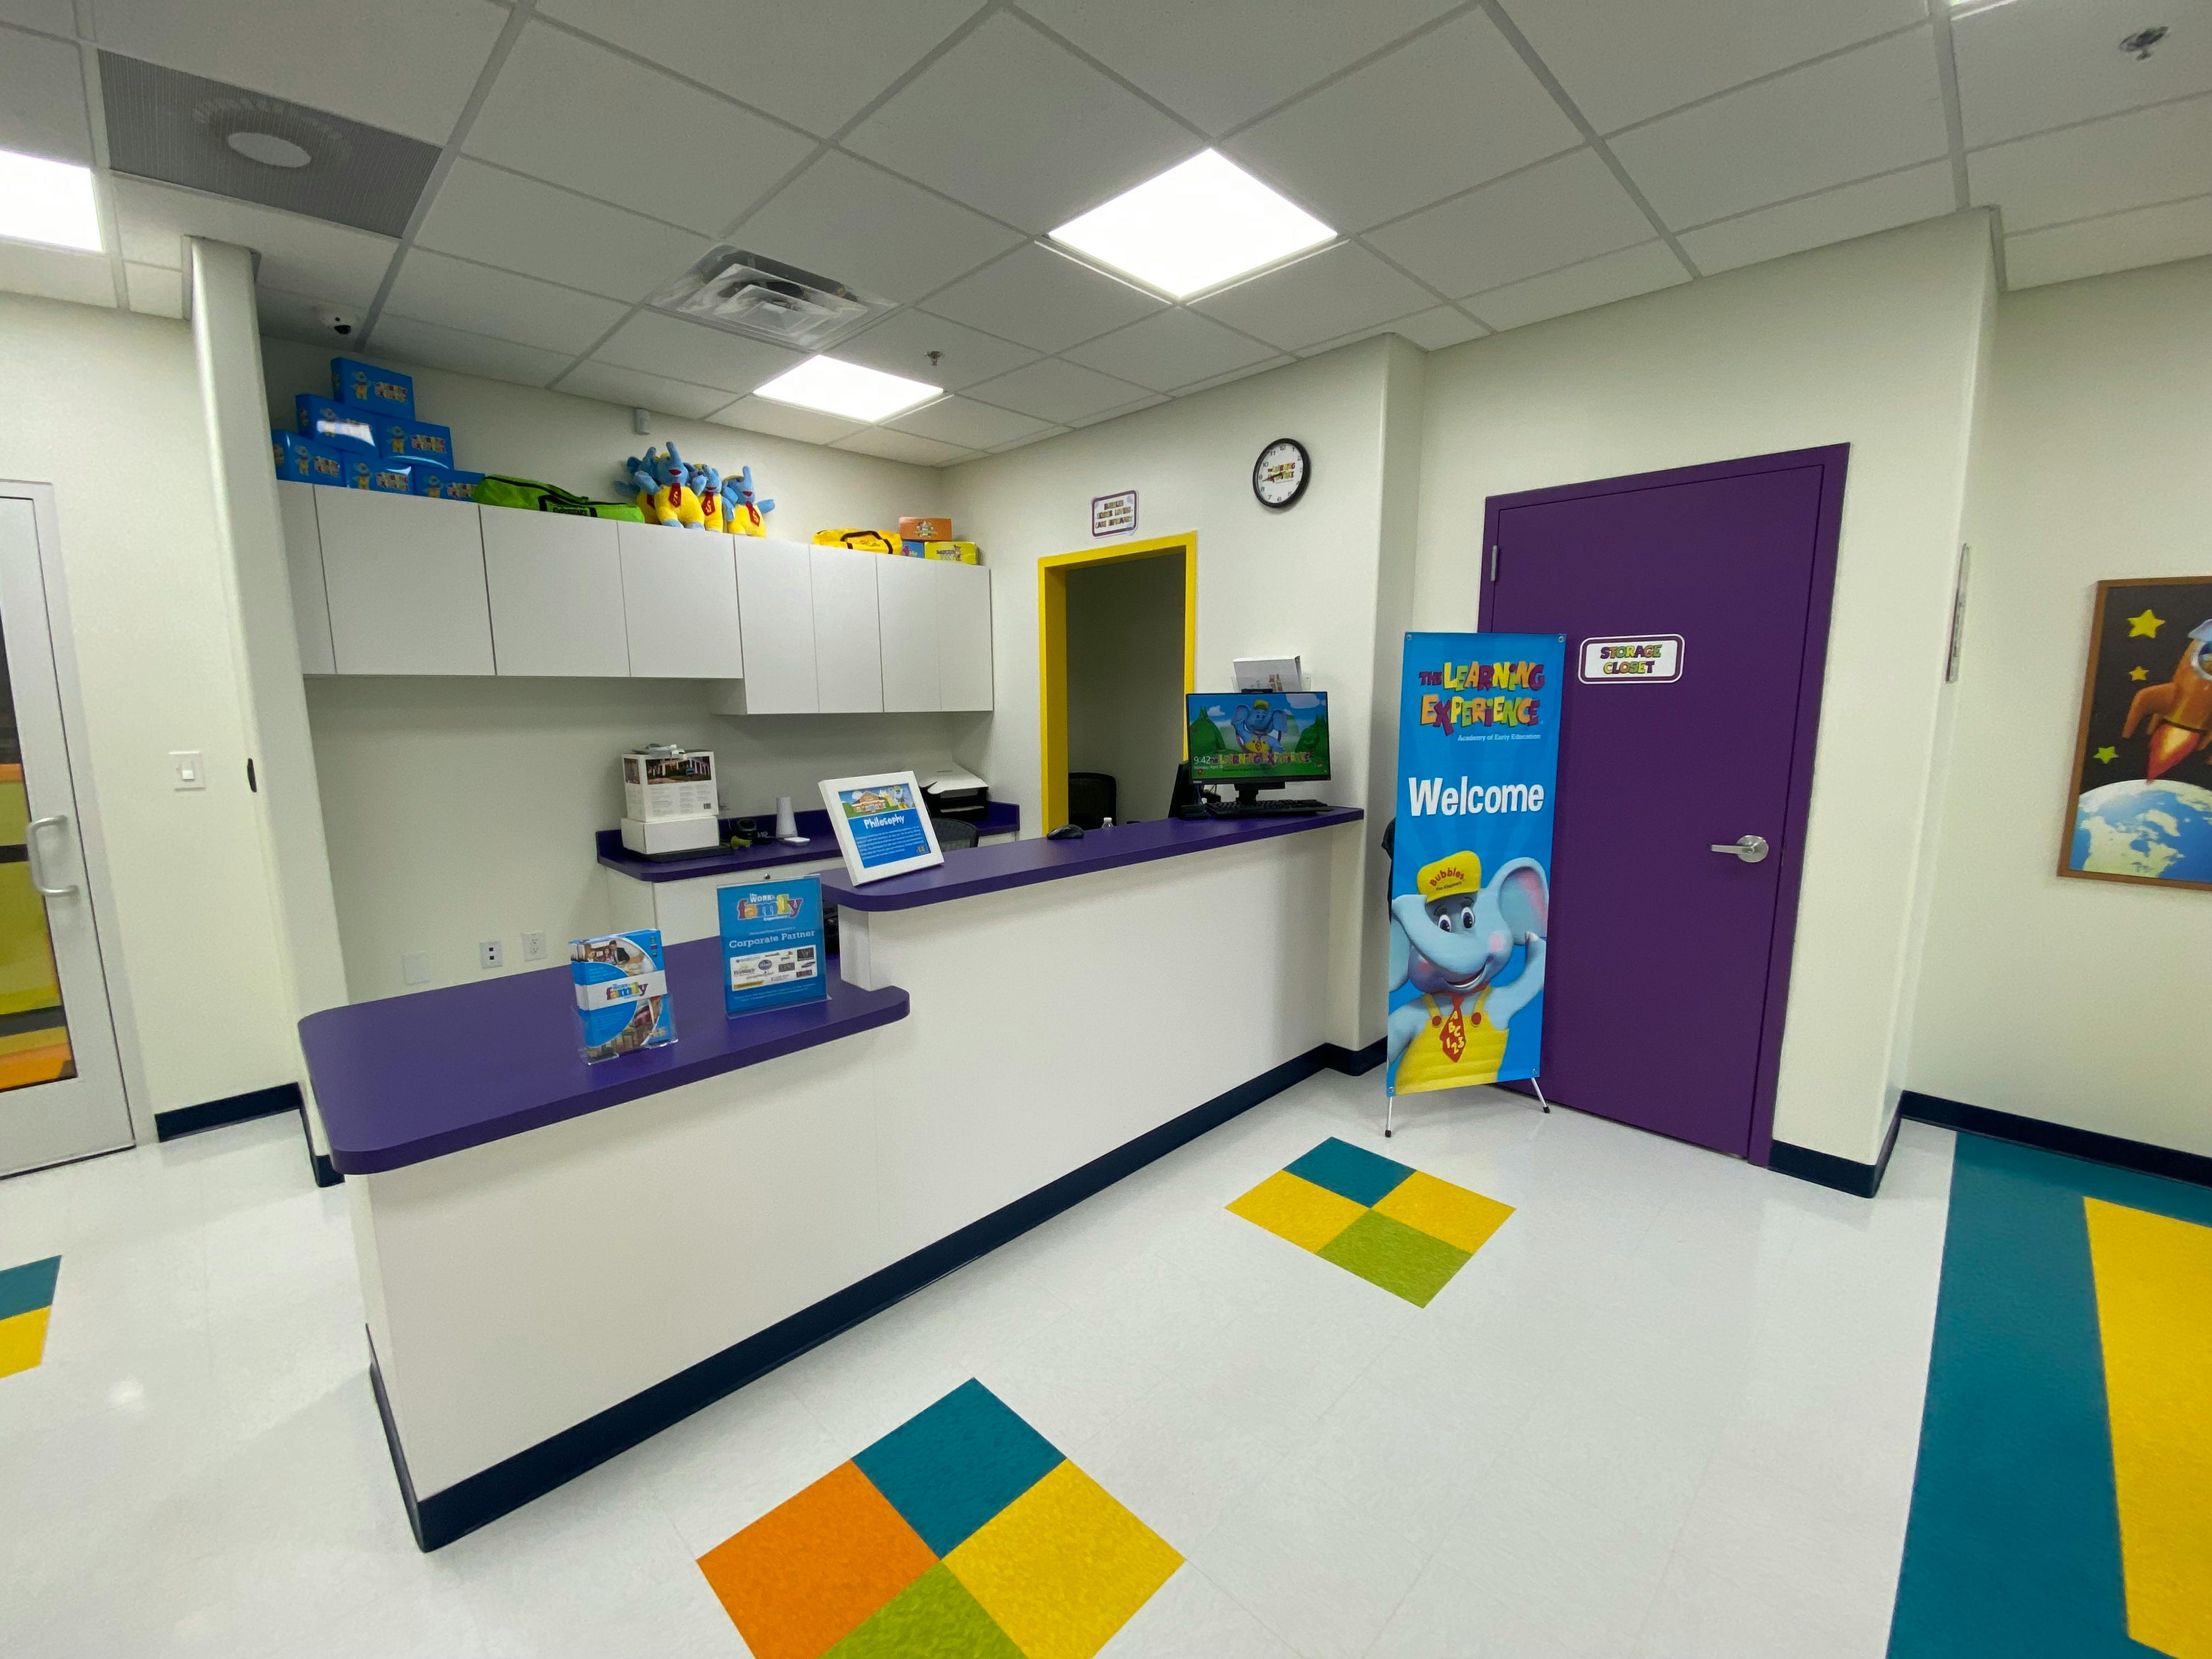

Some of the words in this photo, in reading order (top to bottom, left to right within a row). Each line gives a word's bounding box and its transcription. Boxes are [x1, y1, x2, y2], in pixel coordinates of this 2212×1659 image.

[1600, 644, 1662, 659] STORAGE
[1604, 661, 1655, 674] CLOSET
[1419, 671, 1442, 686] THE
[1443, 661, 1545, 691] LEARNING
[1420, 693, 1540, 736] EXPERIENCE
[1194, 755, 1210, 764] 9:42
[1408, 776, 1544, 816] Welcome
[864, 814, 905, 830] Philosophy
[1430, 867, 1464, 887] Bubbles
[750, 894, 772, 903] WORK
[729, 934, 778, 948] Corporate
[781, 930, 815, 941] Partner
[1450, 1011, 1458, 1020] A
